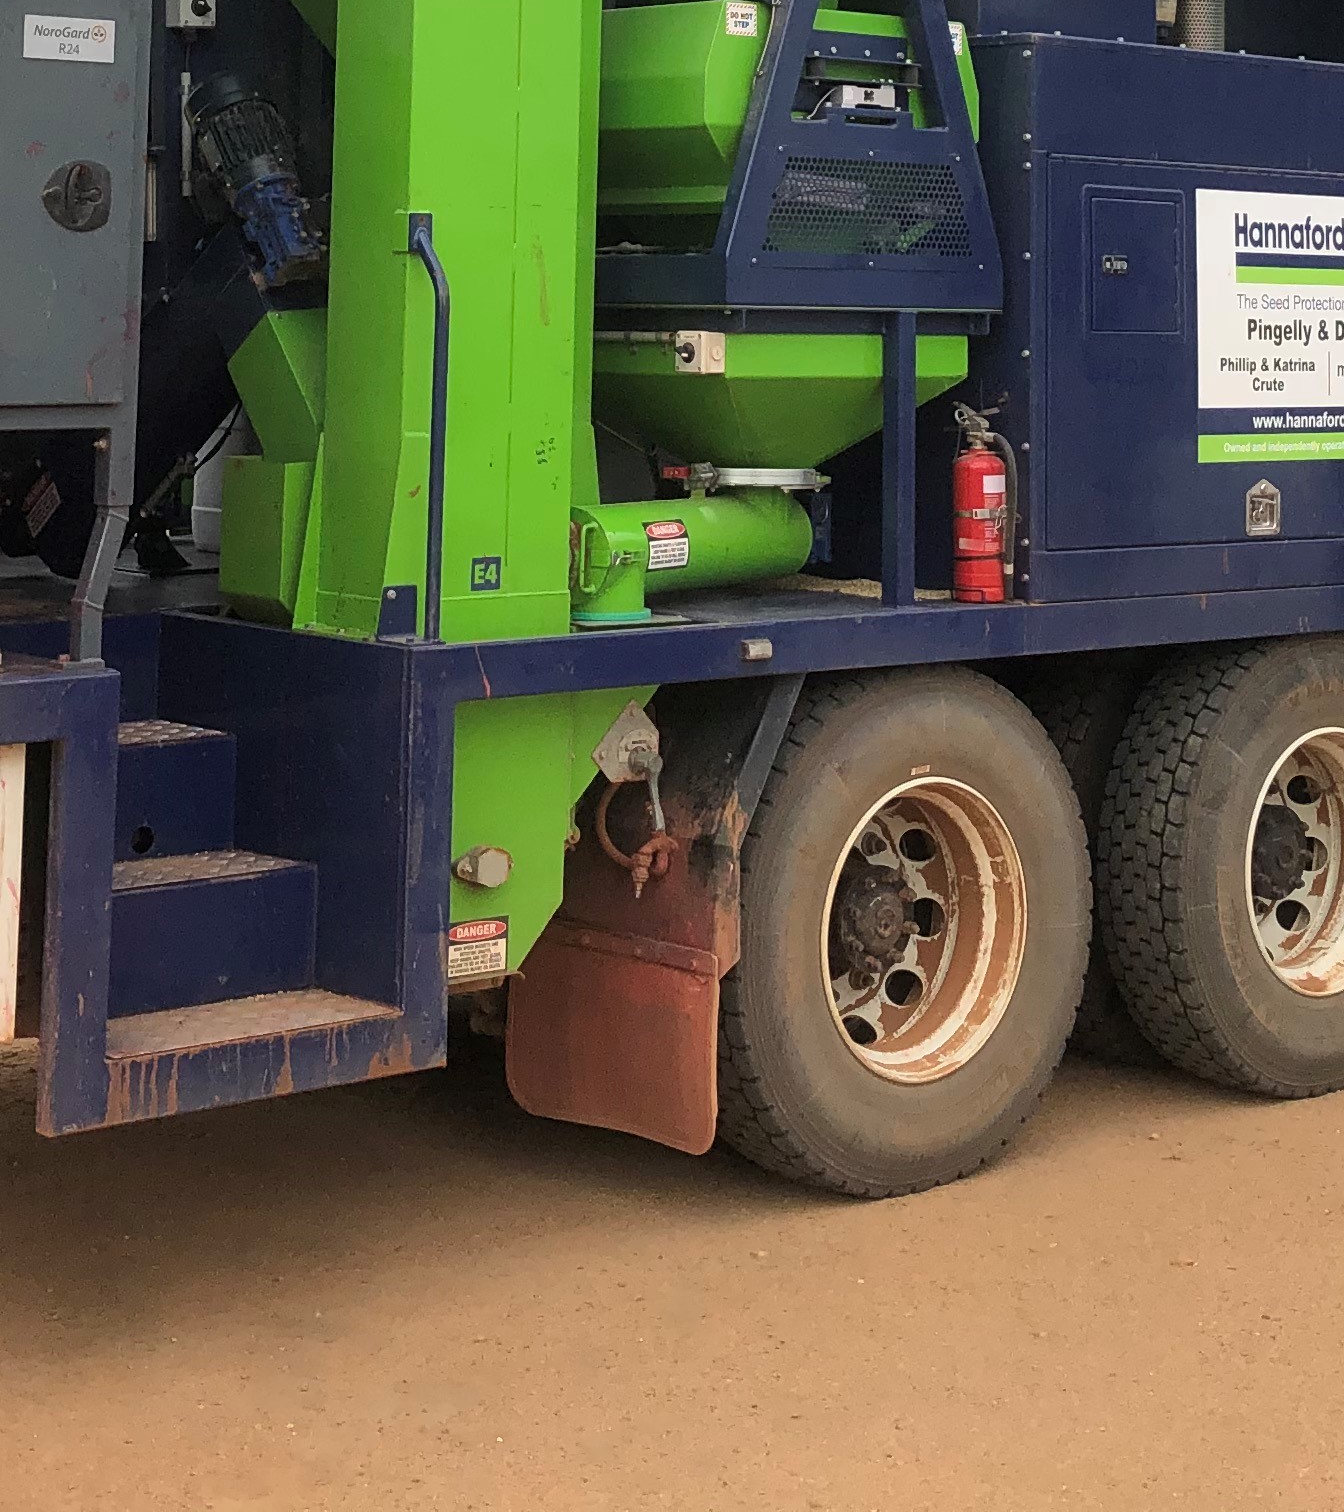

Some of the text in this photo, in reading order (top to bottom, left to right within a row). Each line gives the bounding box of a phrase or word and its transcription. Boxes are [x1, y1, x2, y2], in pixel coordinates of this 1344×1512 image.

[33, 24, 91, 40] NoroGard
[58, 42, 80, 55] R24
[1236, 293, 1258, 310] The
[1261, 294, 1290, 311] Seed
[1247, 318, 1312, 346] Pingelly
[1317, 319, 1330, 341] &
[1220, 357, 1316, 375] Phillip & Katrina
[1252, 376, 1285, 392] Crute
[1223, 442, 1251, 453] Owned
[1252, 441, 1267, 452] and
[474, 563, 498, 584] E4
[456, 923, 497, 938] DANGER
